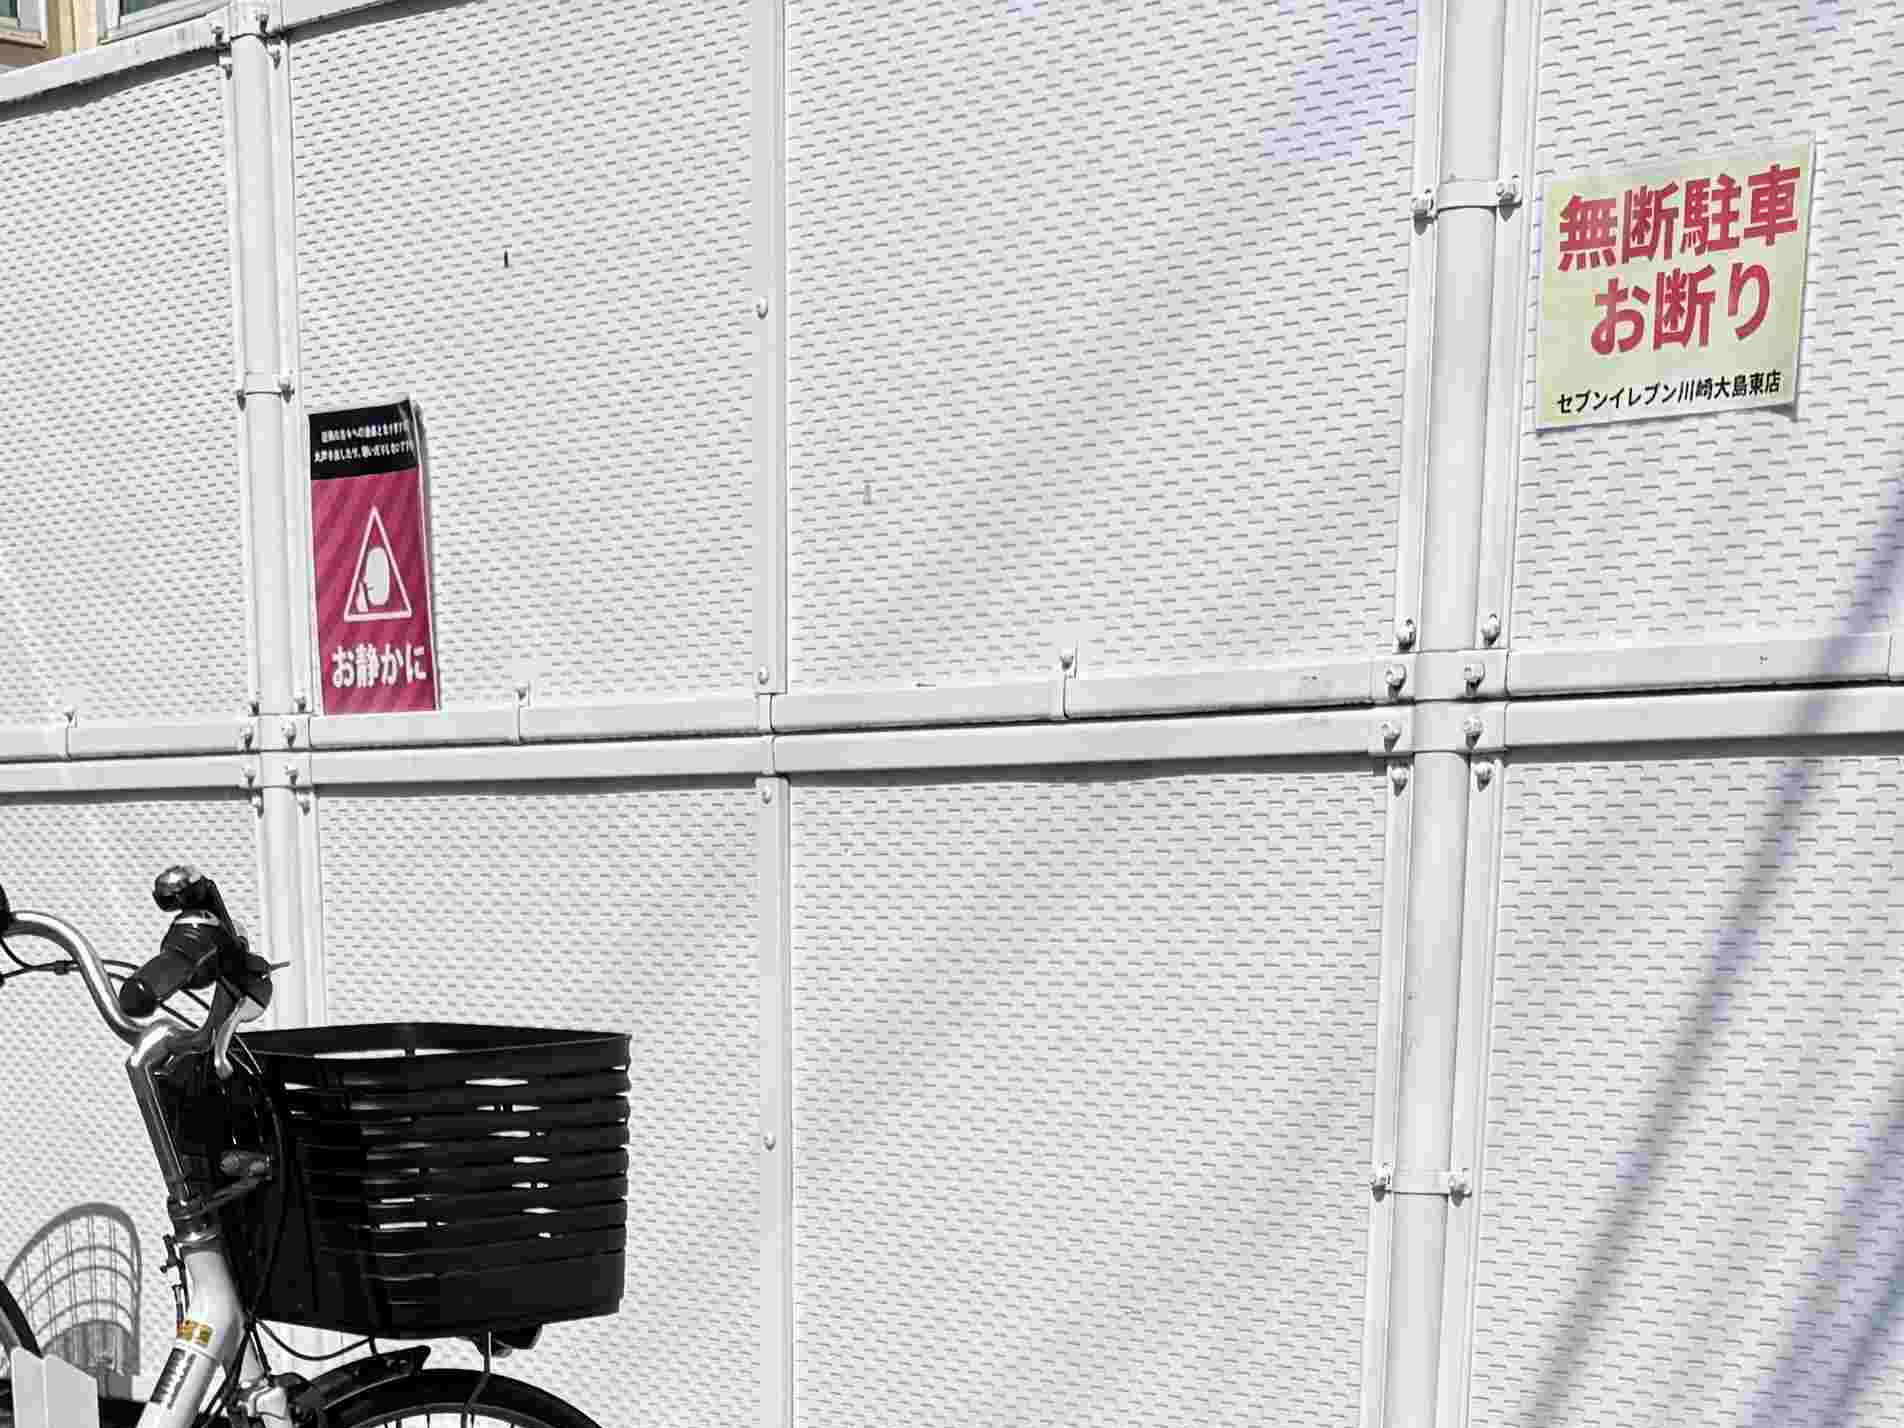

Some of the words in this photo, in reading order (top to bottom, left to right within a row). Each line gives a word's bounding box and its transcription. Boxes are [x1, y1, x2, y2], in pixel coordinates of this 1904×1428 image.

[1558, 164, 1800, 271] 無断駐車
[1590, 262, 1771, 355] お断り
[1557, 368, 1782, 415] セブンイレブン川崎大島東店
[331, 642, 427, 688] お静かに
